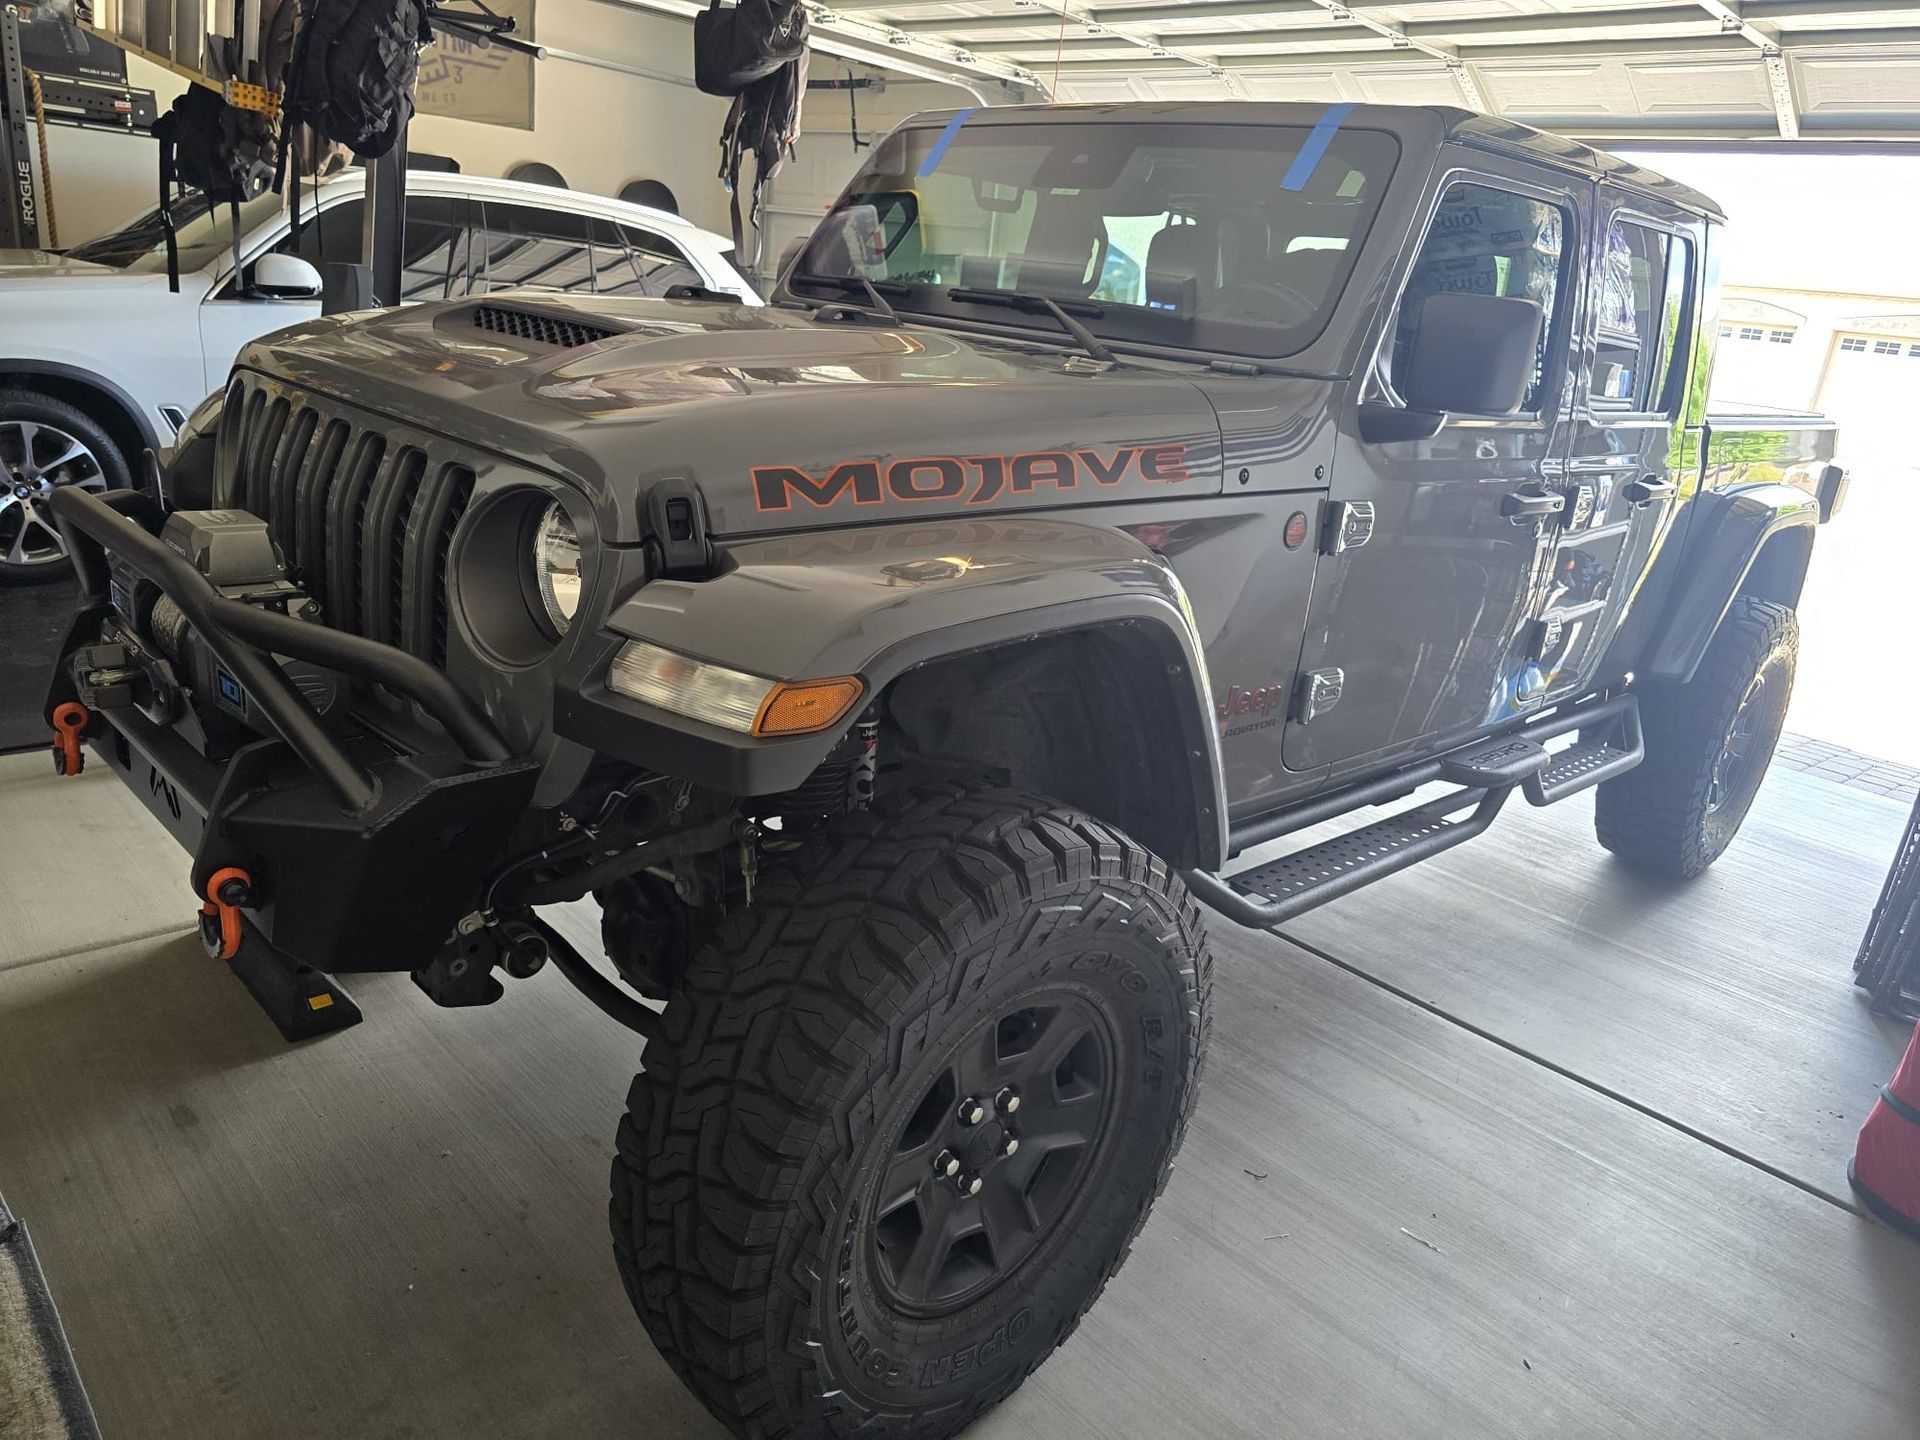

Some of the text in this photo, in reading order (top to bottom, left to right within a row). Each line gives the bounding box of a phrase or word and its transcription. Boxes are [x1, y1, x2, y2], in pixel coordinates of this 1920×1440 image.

[18, 161, 35, 224] ROGUE
[750, 445, 1190, 512] MOJAVE
[1217, 685, 1281, 718] Jeep
[1220, 719, 1277, 739] ADIATOR
[919, 1308, 1034, 1388] OPEN
